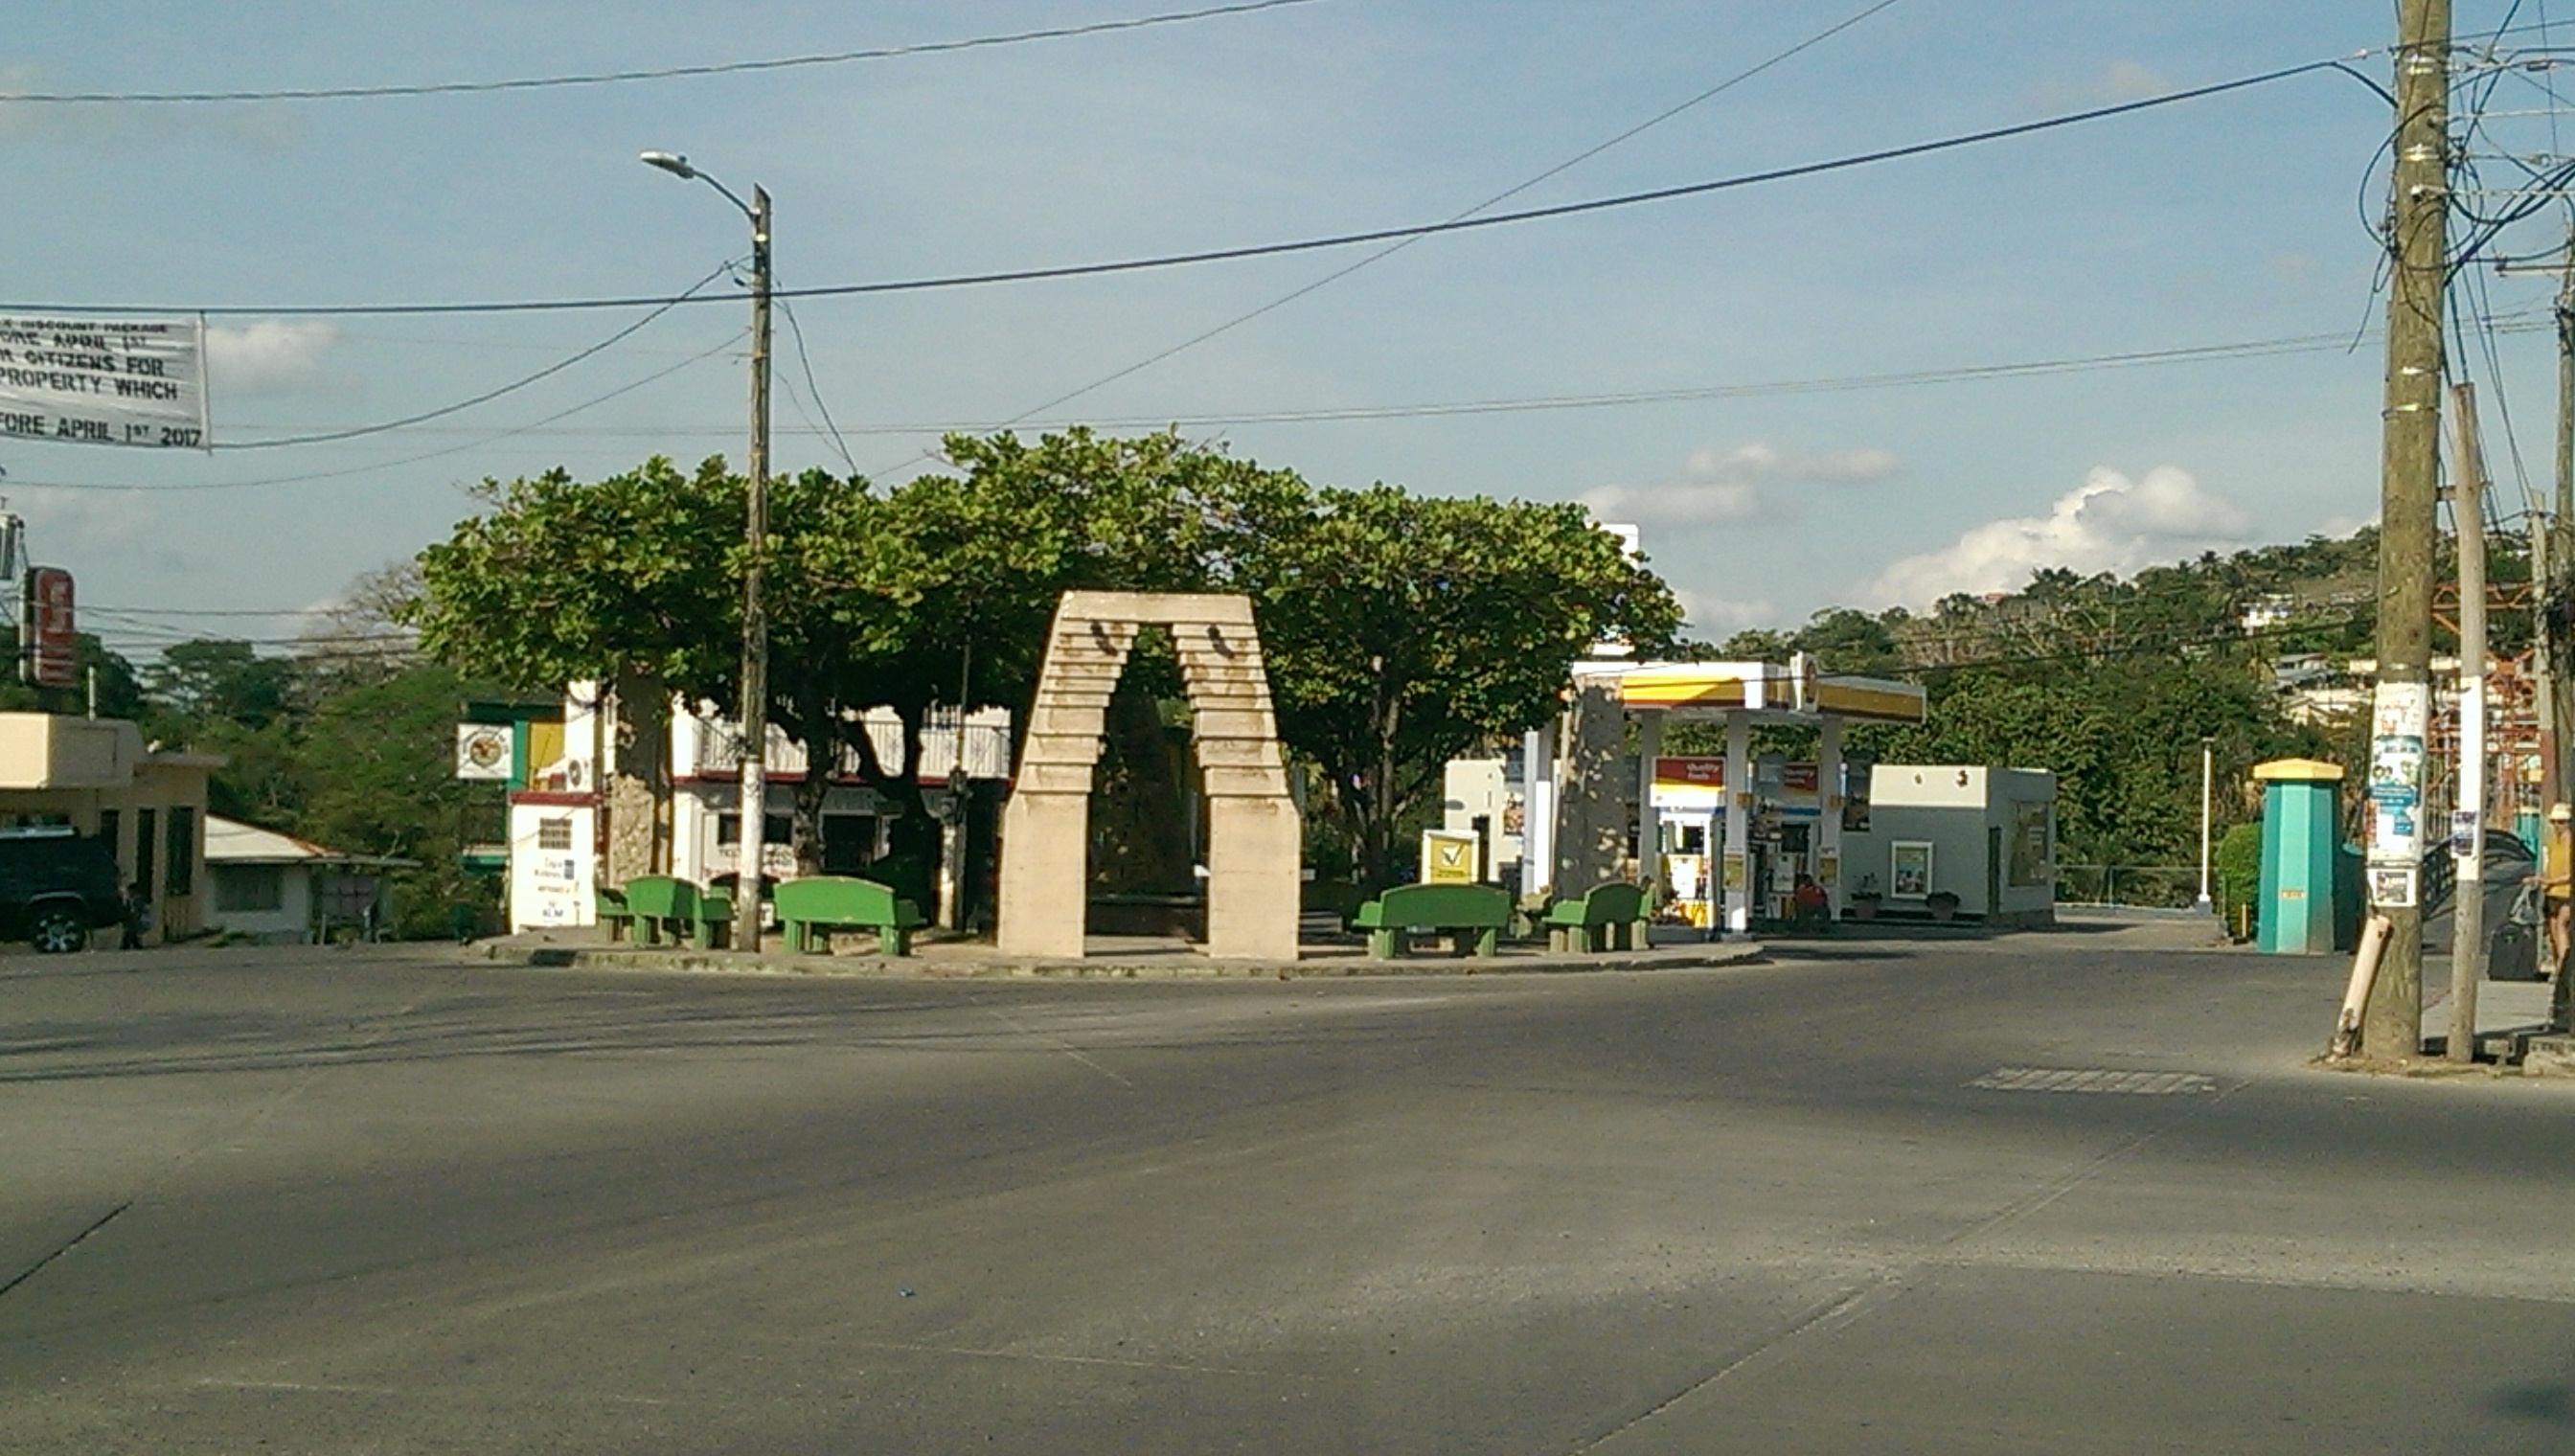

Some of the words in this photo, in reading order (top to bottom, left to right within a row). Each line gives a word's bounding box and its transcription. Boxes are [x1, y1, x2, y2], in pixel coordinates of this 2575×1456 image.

[25, 350, 116, 373] CITIZENS
[125, 356, 165, 377] FOR
[114, 377, 178, 400] WHICH
[56, 418, 115, 442] APRIL
[160, 425, 202, 447] 2017
